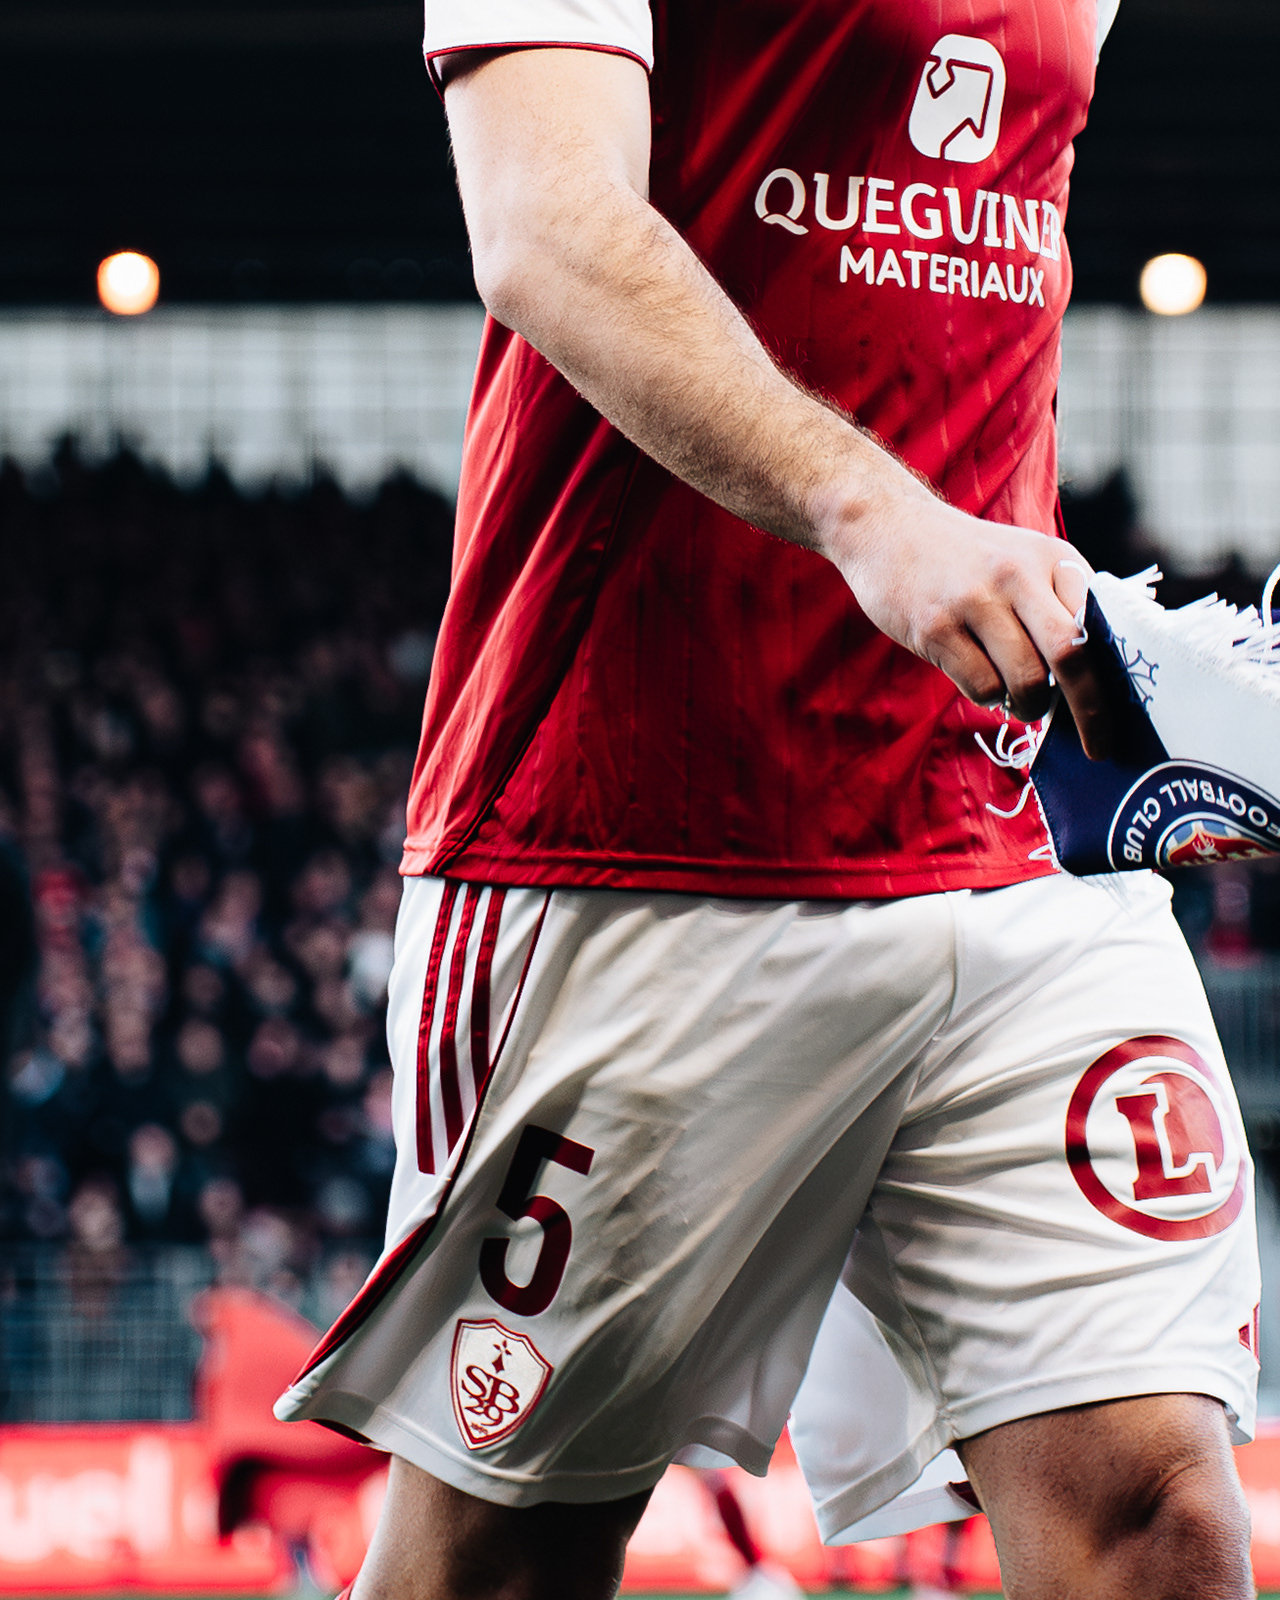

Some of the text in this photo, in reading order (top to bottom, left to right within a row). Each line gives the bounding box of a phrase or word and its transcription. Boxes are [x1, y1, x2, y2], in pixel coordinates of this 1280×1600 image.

[754, 167, 1062, 262] QUEGUINER
[838, 244, 1046, 308] MATERIAUX
[1123, 796, 1162, 863] CLUB
[478, 1123, 596, 1318] 5
